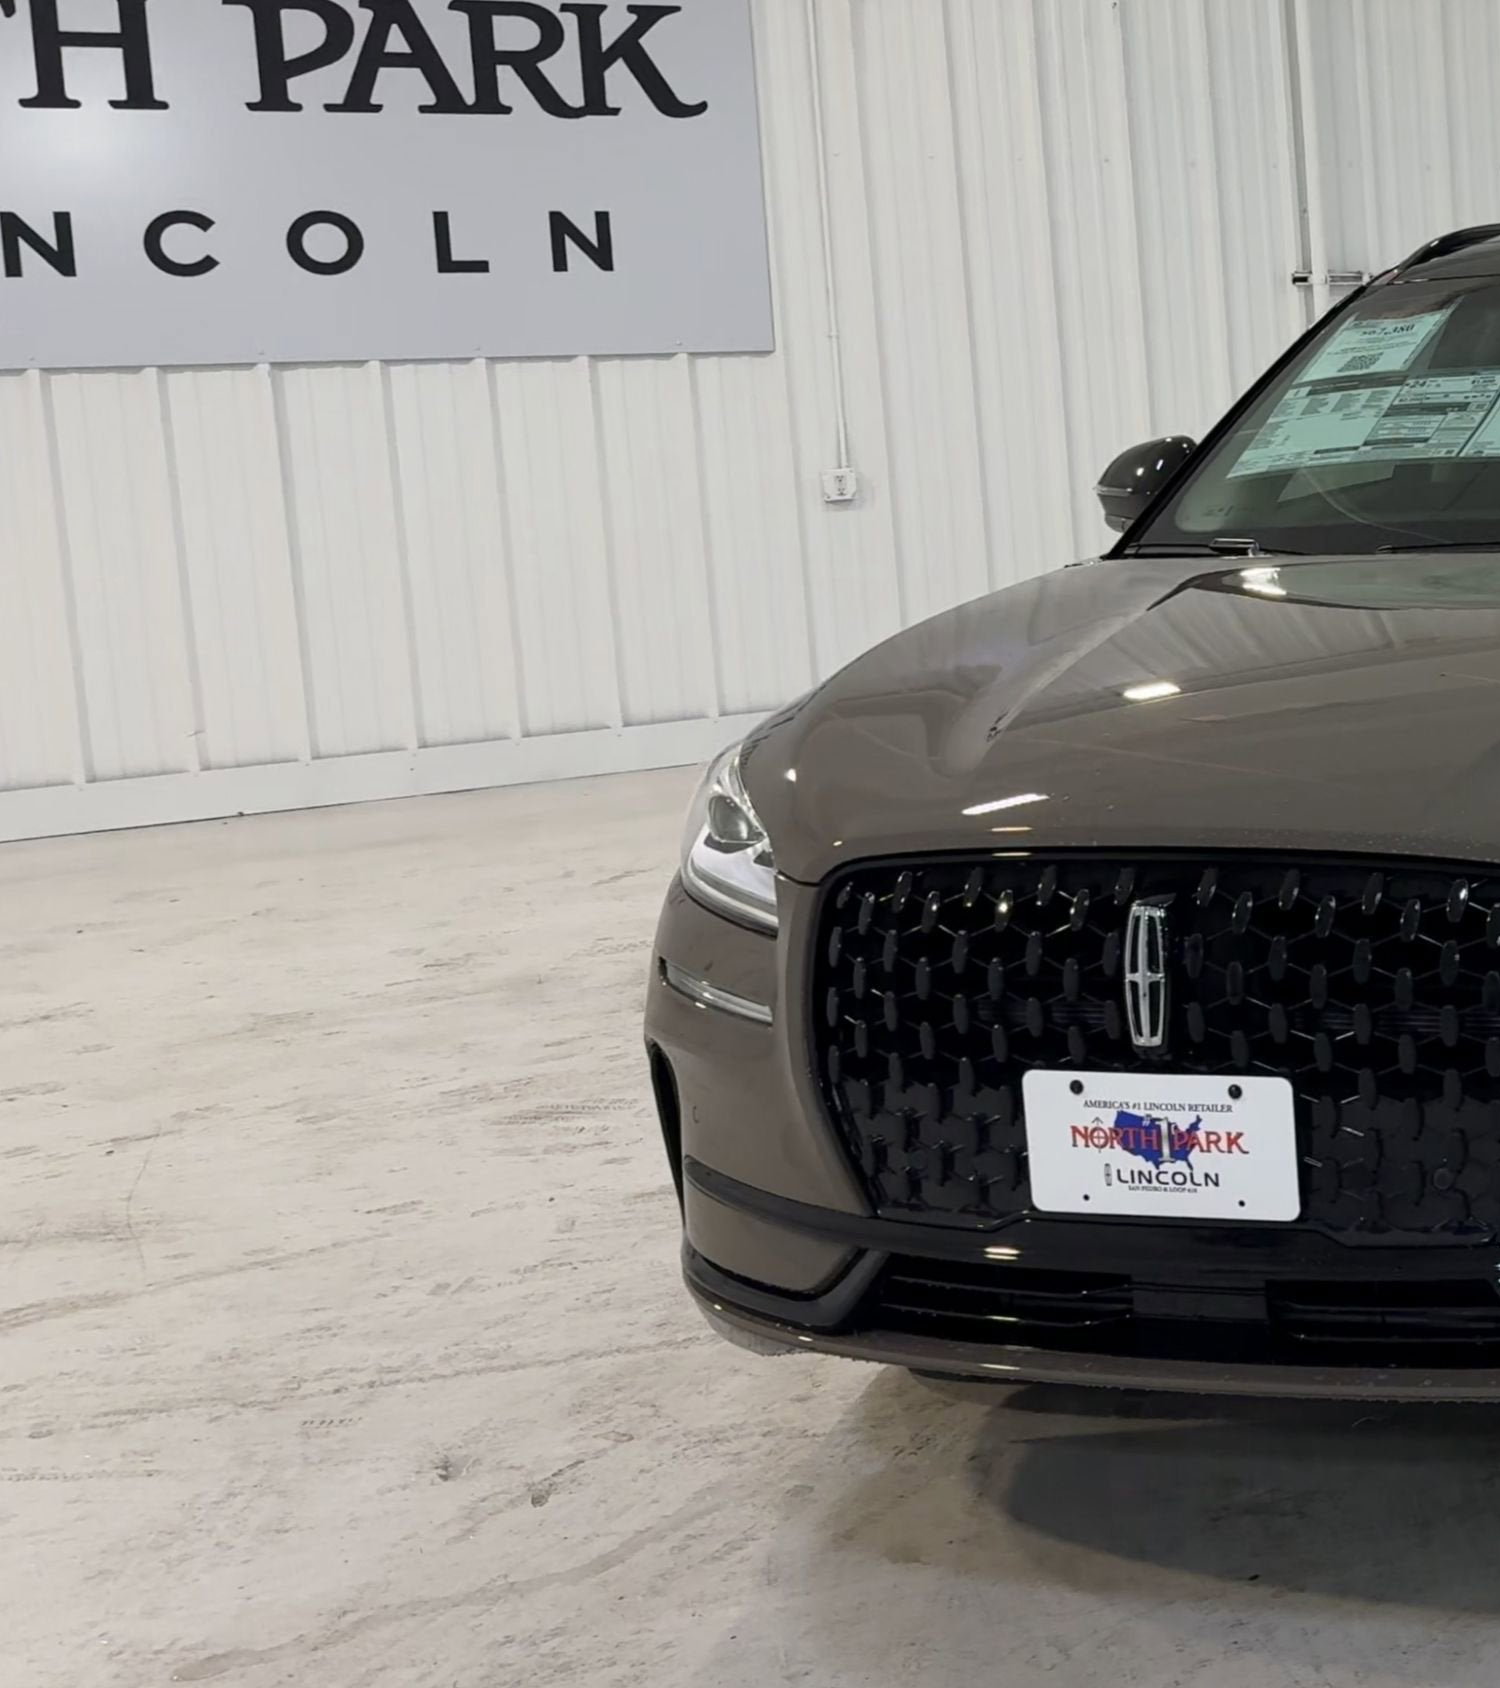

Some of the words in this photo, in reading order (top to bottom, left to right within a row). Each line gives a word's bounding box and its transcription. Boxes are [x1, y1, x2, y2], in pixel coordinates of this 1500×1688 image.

[221, 0, 709, 119] PARK
[1083, 1100, 1130, 1109] AMERICA'S
[1132, 1101, 1141, 1110] #1
[1143, 1102, 1186, 1111] LINCOLN
[1188, 1103, 1233, 1113] RETAILER
[1071, 1125, 1158, 1151] NORTH
[1174, 1130, 1250, 1154] PARK
[1116, 1168, 1220, 1187] LINCOLN
